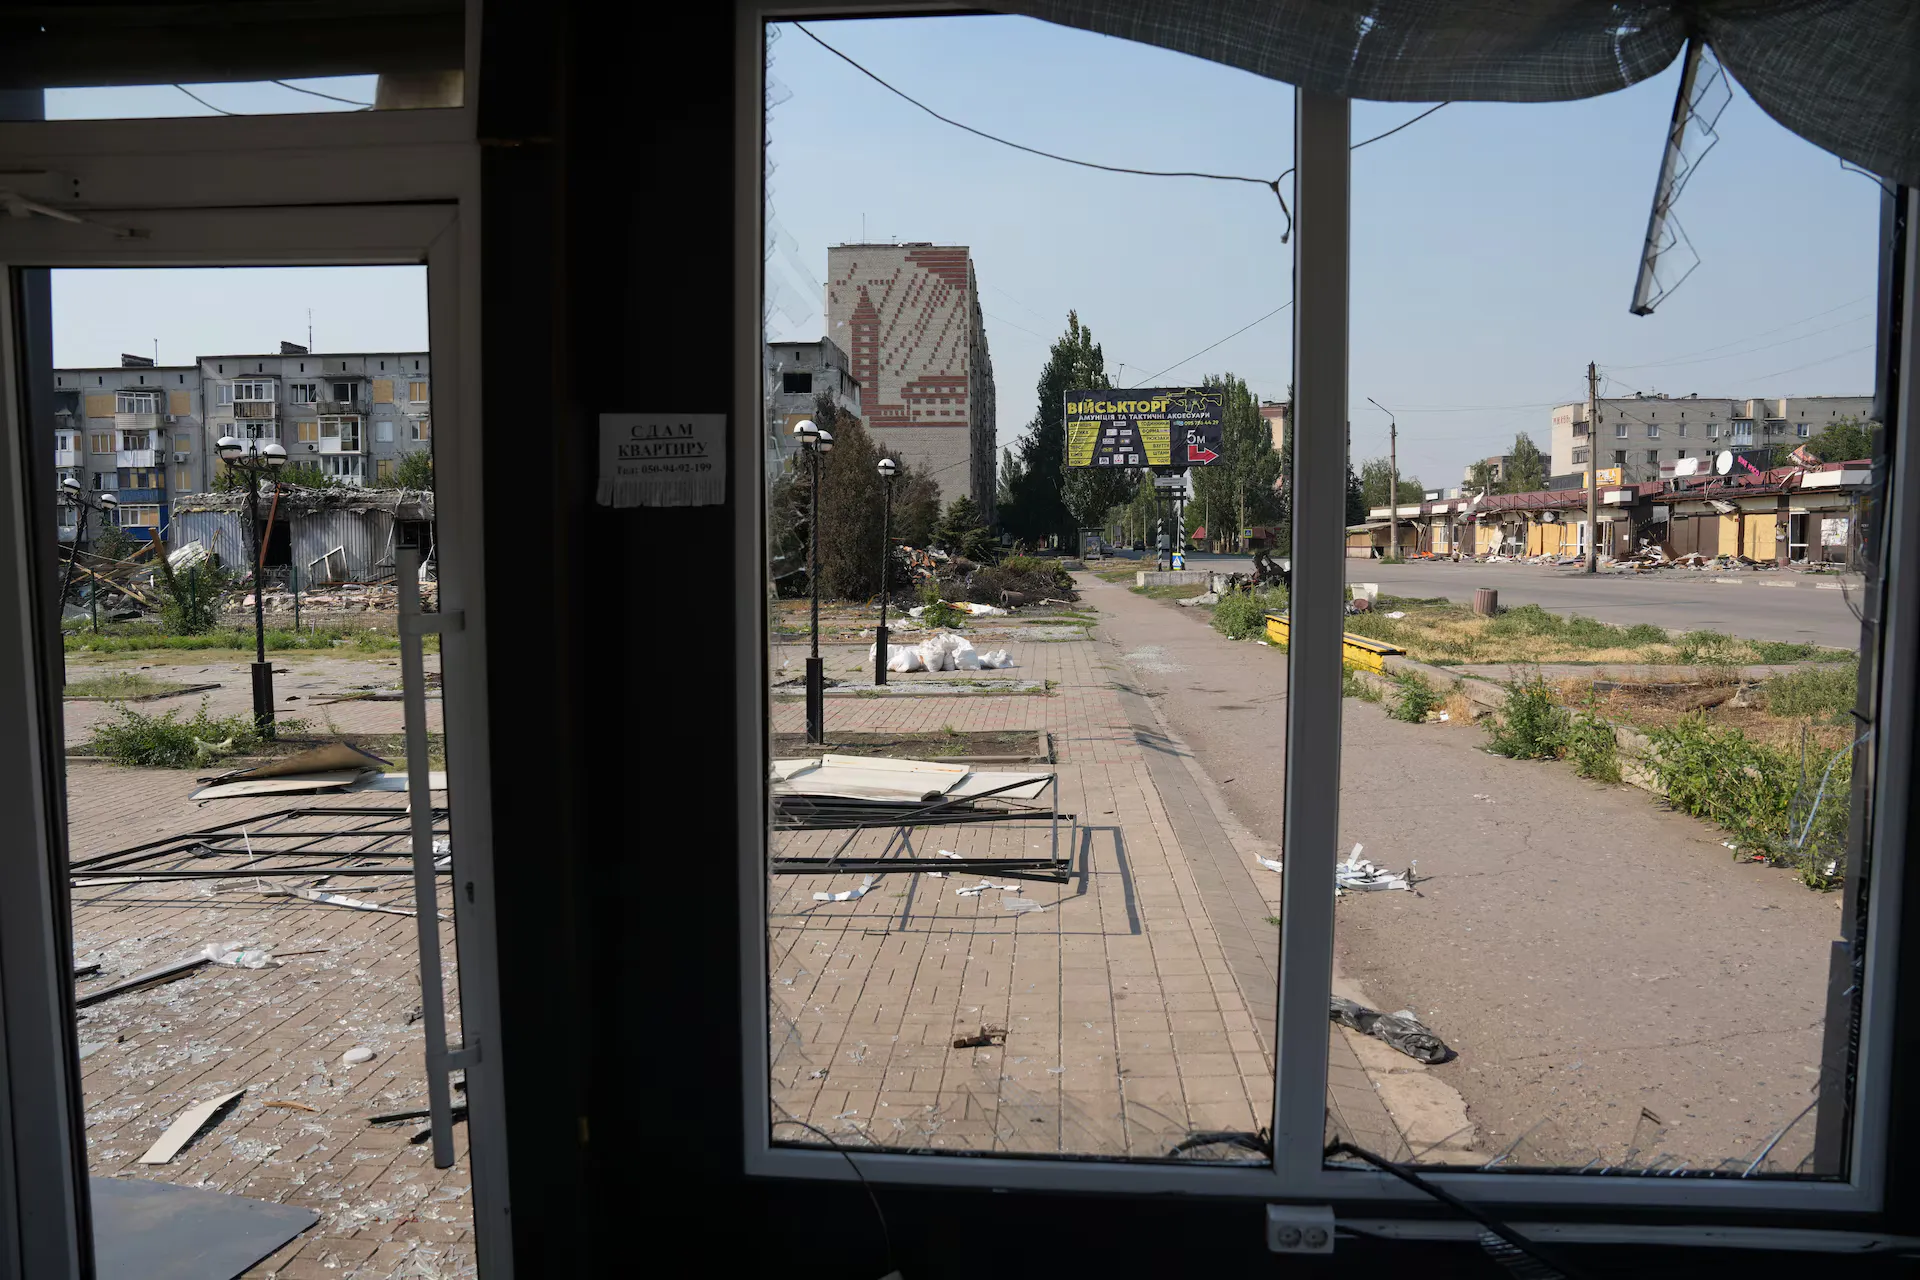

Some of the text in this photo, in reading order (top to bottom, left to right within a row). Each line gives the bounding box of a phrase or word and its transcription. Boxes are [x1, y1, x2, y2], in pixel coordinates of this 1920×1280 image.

[1067, 400, 1169, 413] ВІЙСЬКТОРГ
[1079, 413, 1115, 421] АМУНІЦІЯ
[631, 423, 693, 437] СДАМ
[618, 442, 708, 457] КВАРТИРУ
